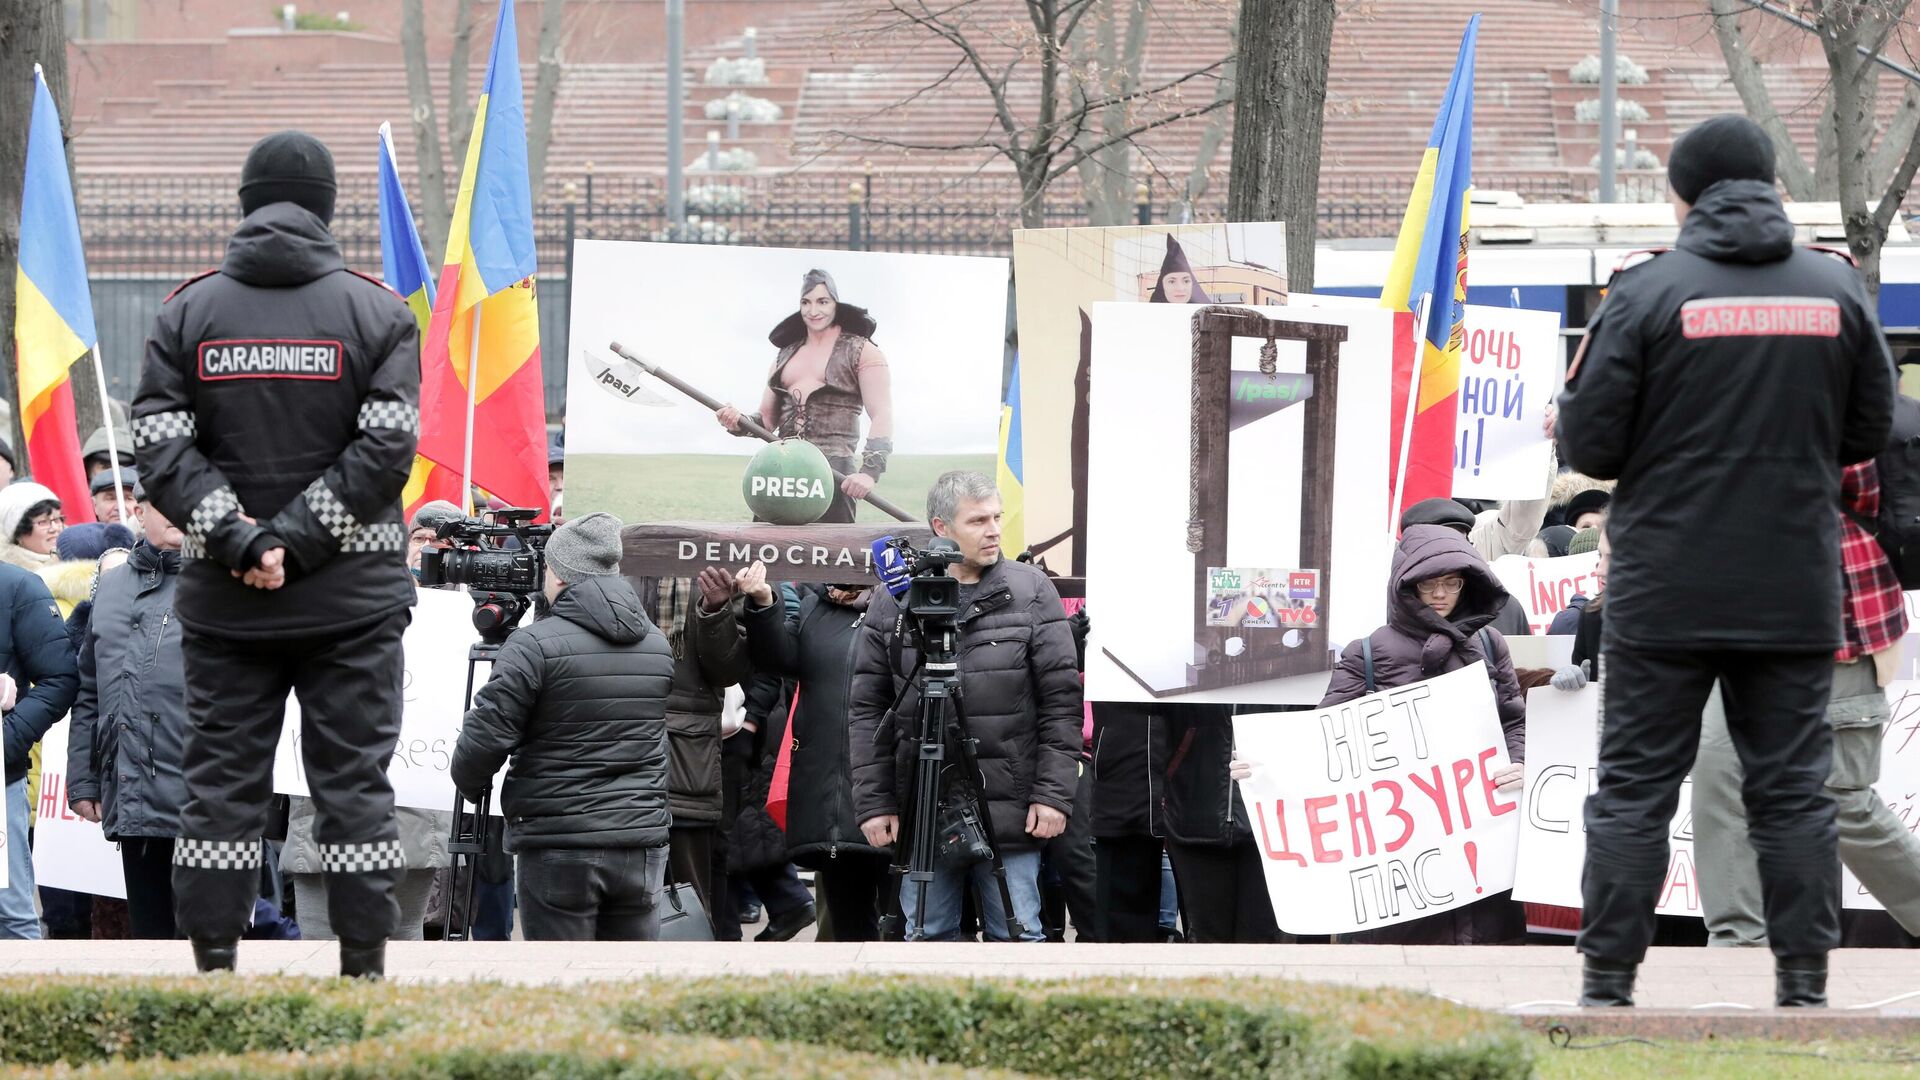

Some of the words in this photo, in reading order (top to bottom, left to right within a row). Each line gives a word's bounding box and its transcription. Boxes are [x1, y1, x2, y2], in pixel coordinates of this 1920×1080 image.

[1684, 308, 1839, 334] CARABINIERI
[205, 346, 336, 373] CARABINIERI
[597, 367, 641, 398] /pas/
[1236, 377, 1303, 402] /pas/
[1462, 373, 1525, 421] НОЙ
[751, 476, 826, 499] PRESA
[678, 541, 873, 574] DEMOCRAȚ
[1213, 571, 1240, 587] NTV
[1293, 578, 1311, 586] RTR
[894, 613, 904, 638] SONY
[1278, 605, 1317, 623] TV6
[1320, 684, 1431, 782] НЕТ
[1255, 746, 1517, 868] ЦЕНЗУРЕ
[1349, 847, 1455, 925] ПАС
